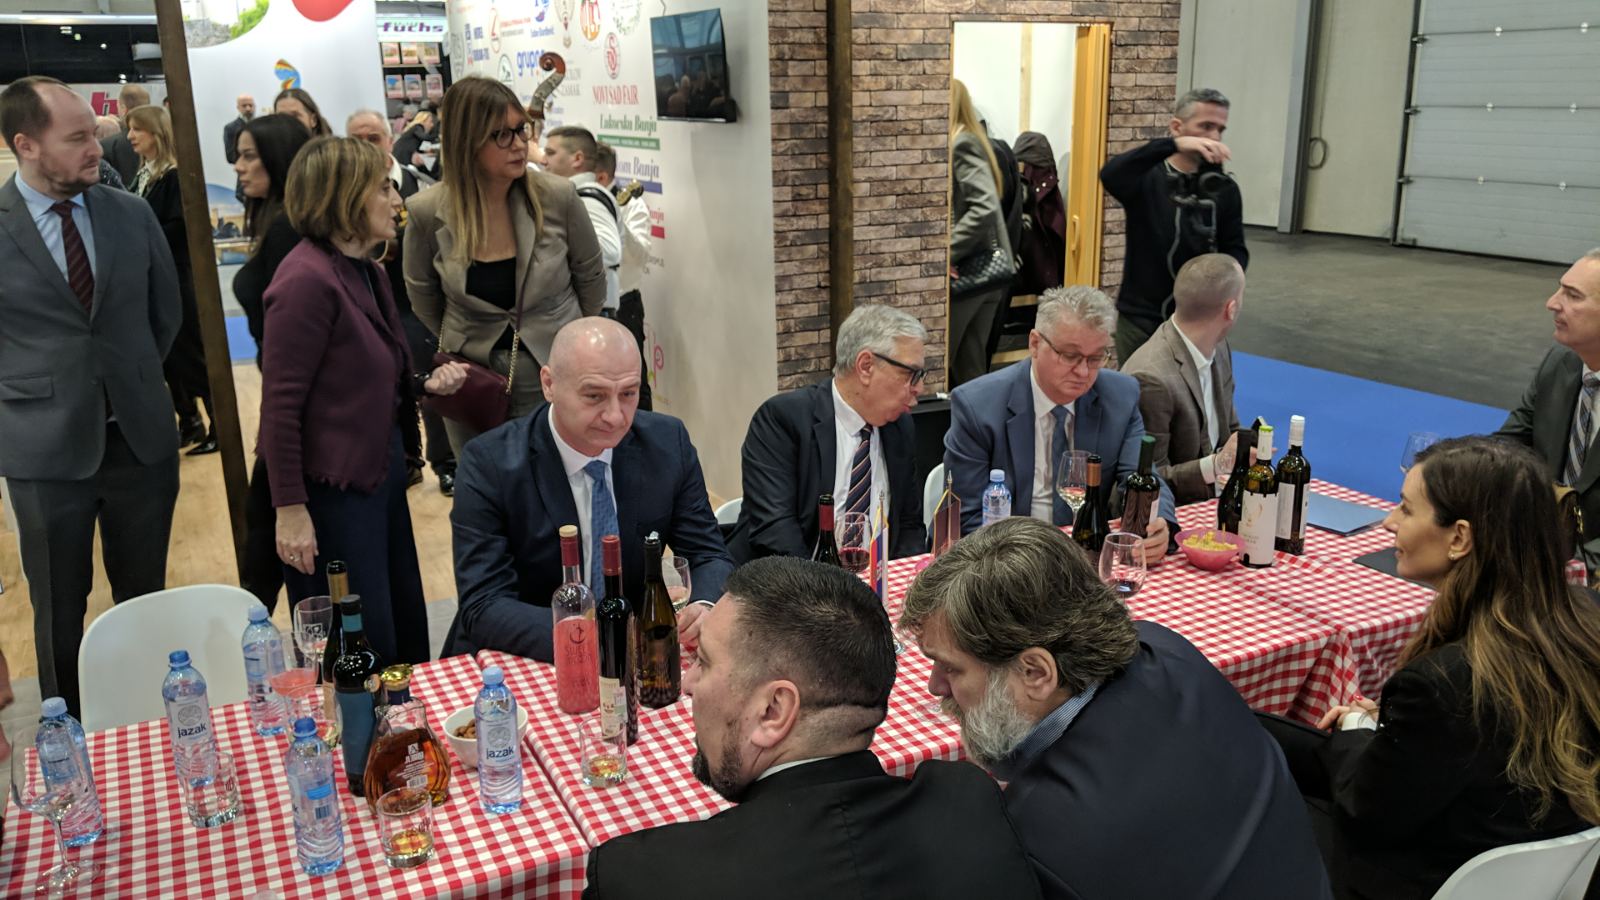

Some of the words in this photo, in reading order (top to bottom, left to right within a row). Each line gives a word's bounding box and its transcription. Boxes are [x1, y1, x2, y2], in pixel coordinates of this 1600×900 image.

[383, 21, 443, 32] fuchs
[622, 85, 639, 105] FAIR
[633, 156, 660, 181] Banja
[177, 722, 207, 738] jazak
[486, 746, 514, 760] jazak
